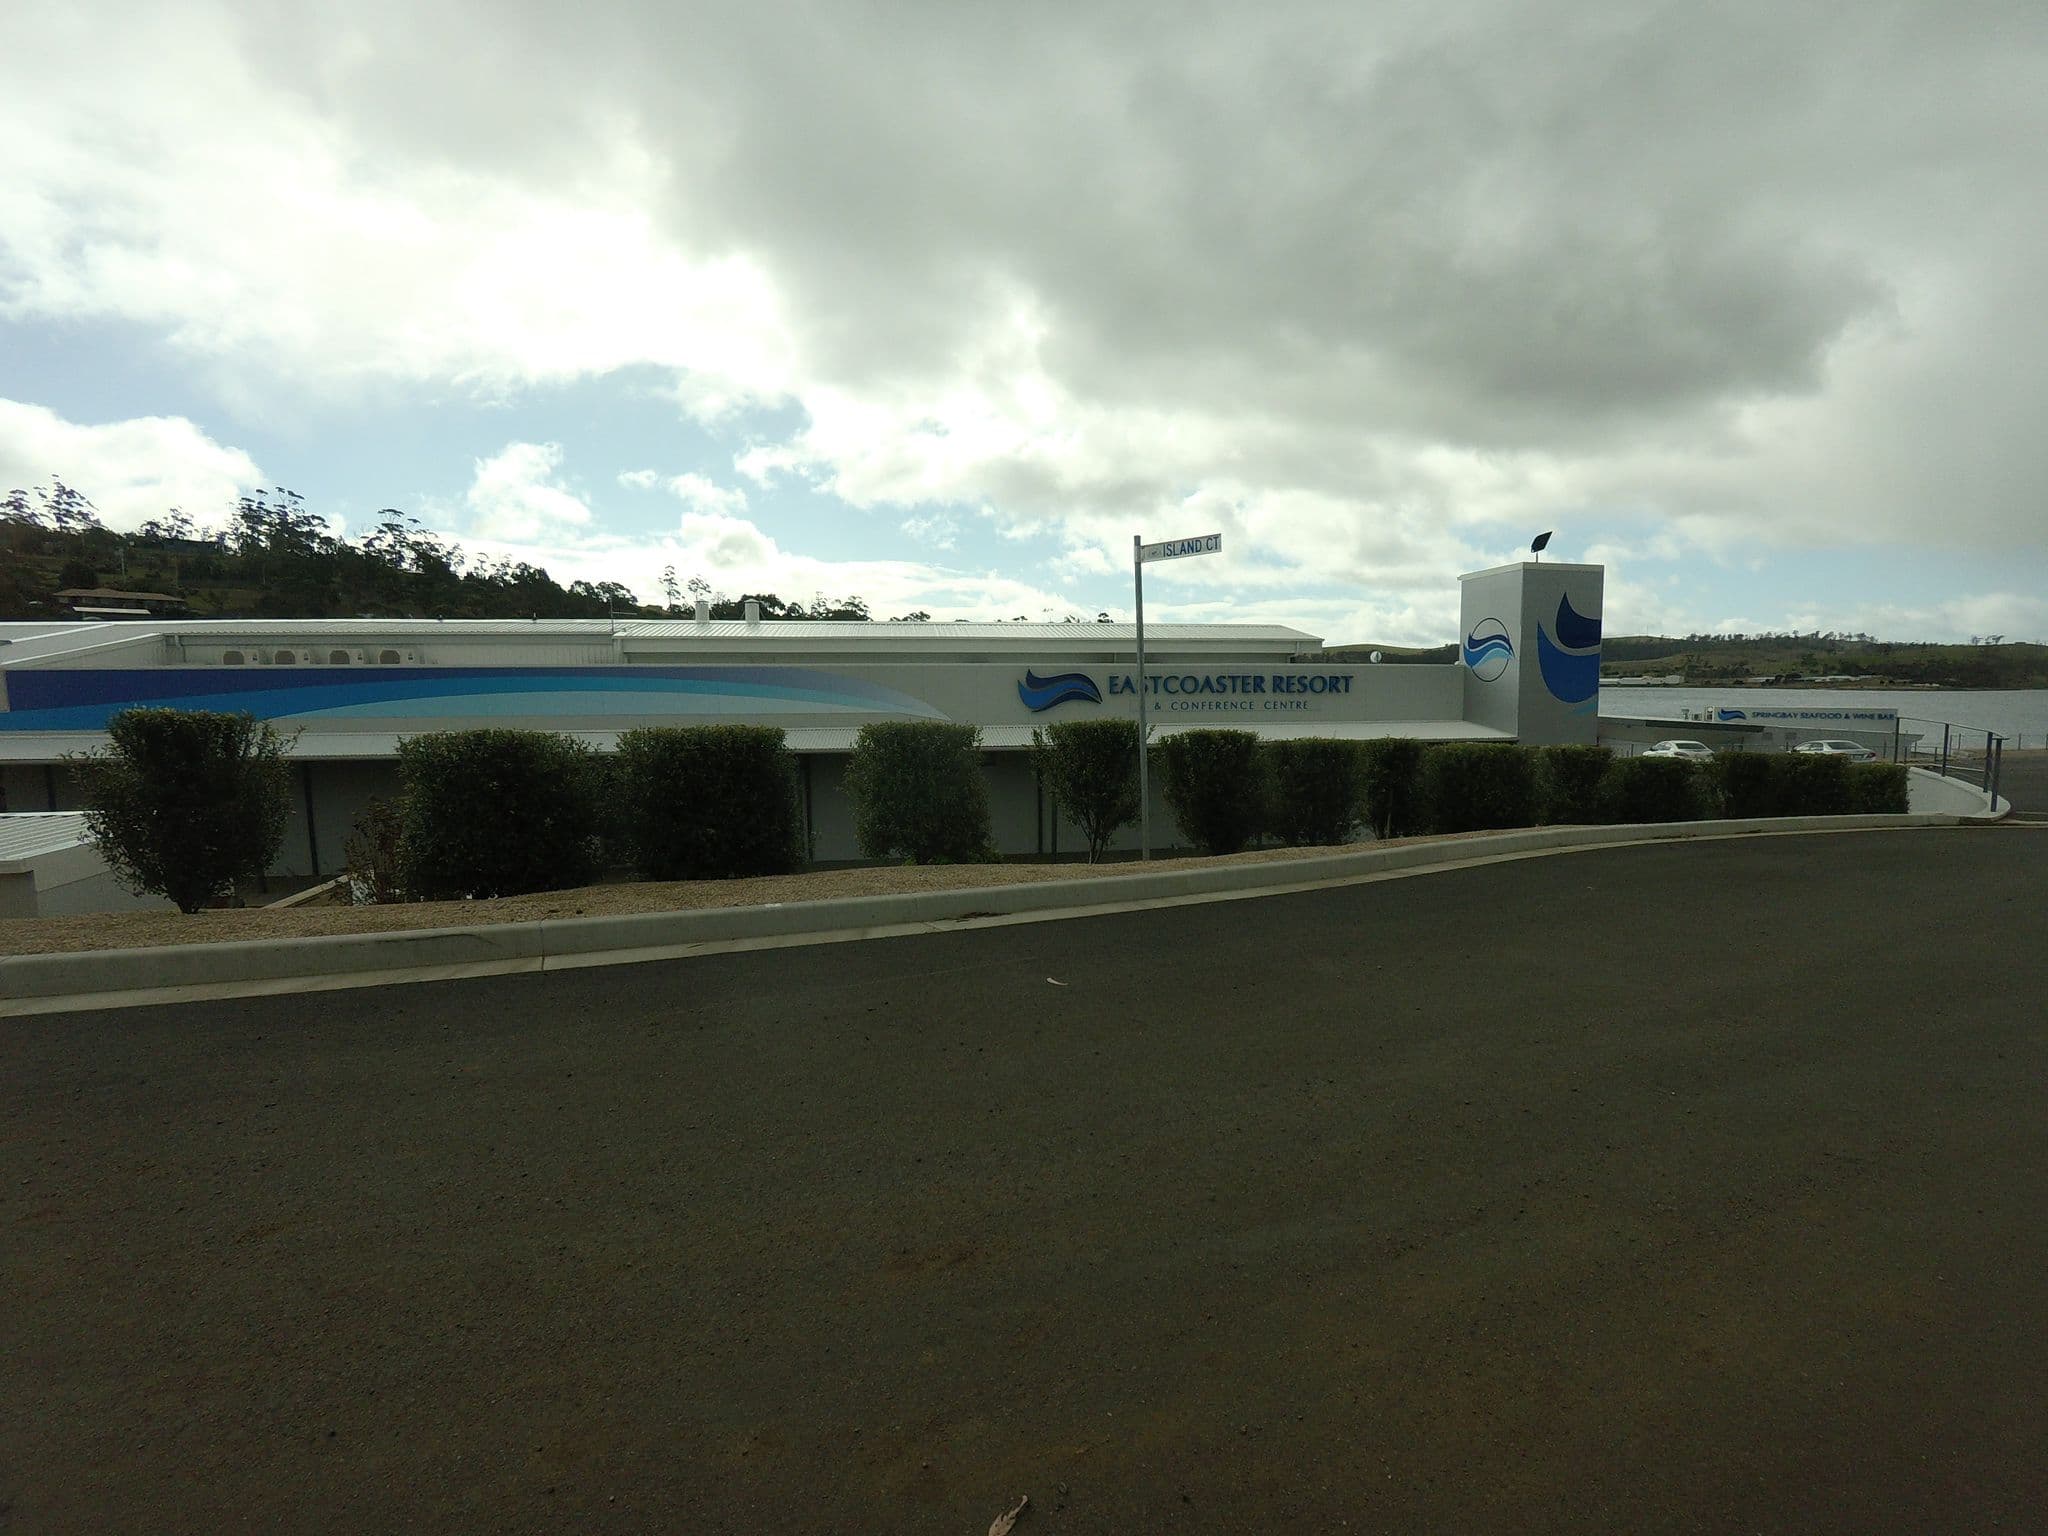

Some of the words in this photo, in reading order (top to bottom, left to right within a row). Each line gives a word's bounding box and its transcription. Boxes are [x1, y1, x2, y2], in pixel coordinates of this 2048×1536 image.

[1163, 539, 1202, 557] ISLAND
[1206, 536, 1219, 550] CT
[1272, 675, 1353, 693] RESORT
[1154, 702, 1161, 710] &
[1171, 701, 1254, 710] CONFERENCE
[1264, 701, 1309, 710] CENTRE
[1800, 712, 1842, 720] SEAFOOD
[1877, 712, 1895, 720] BAR
